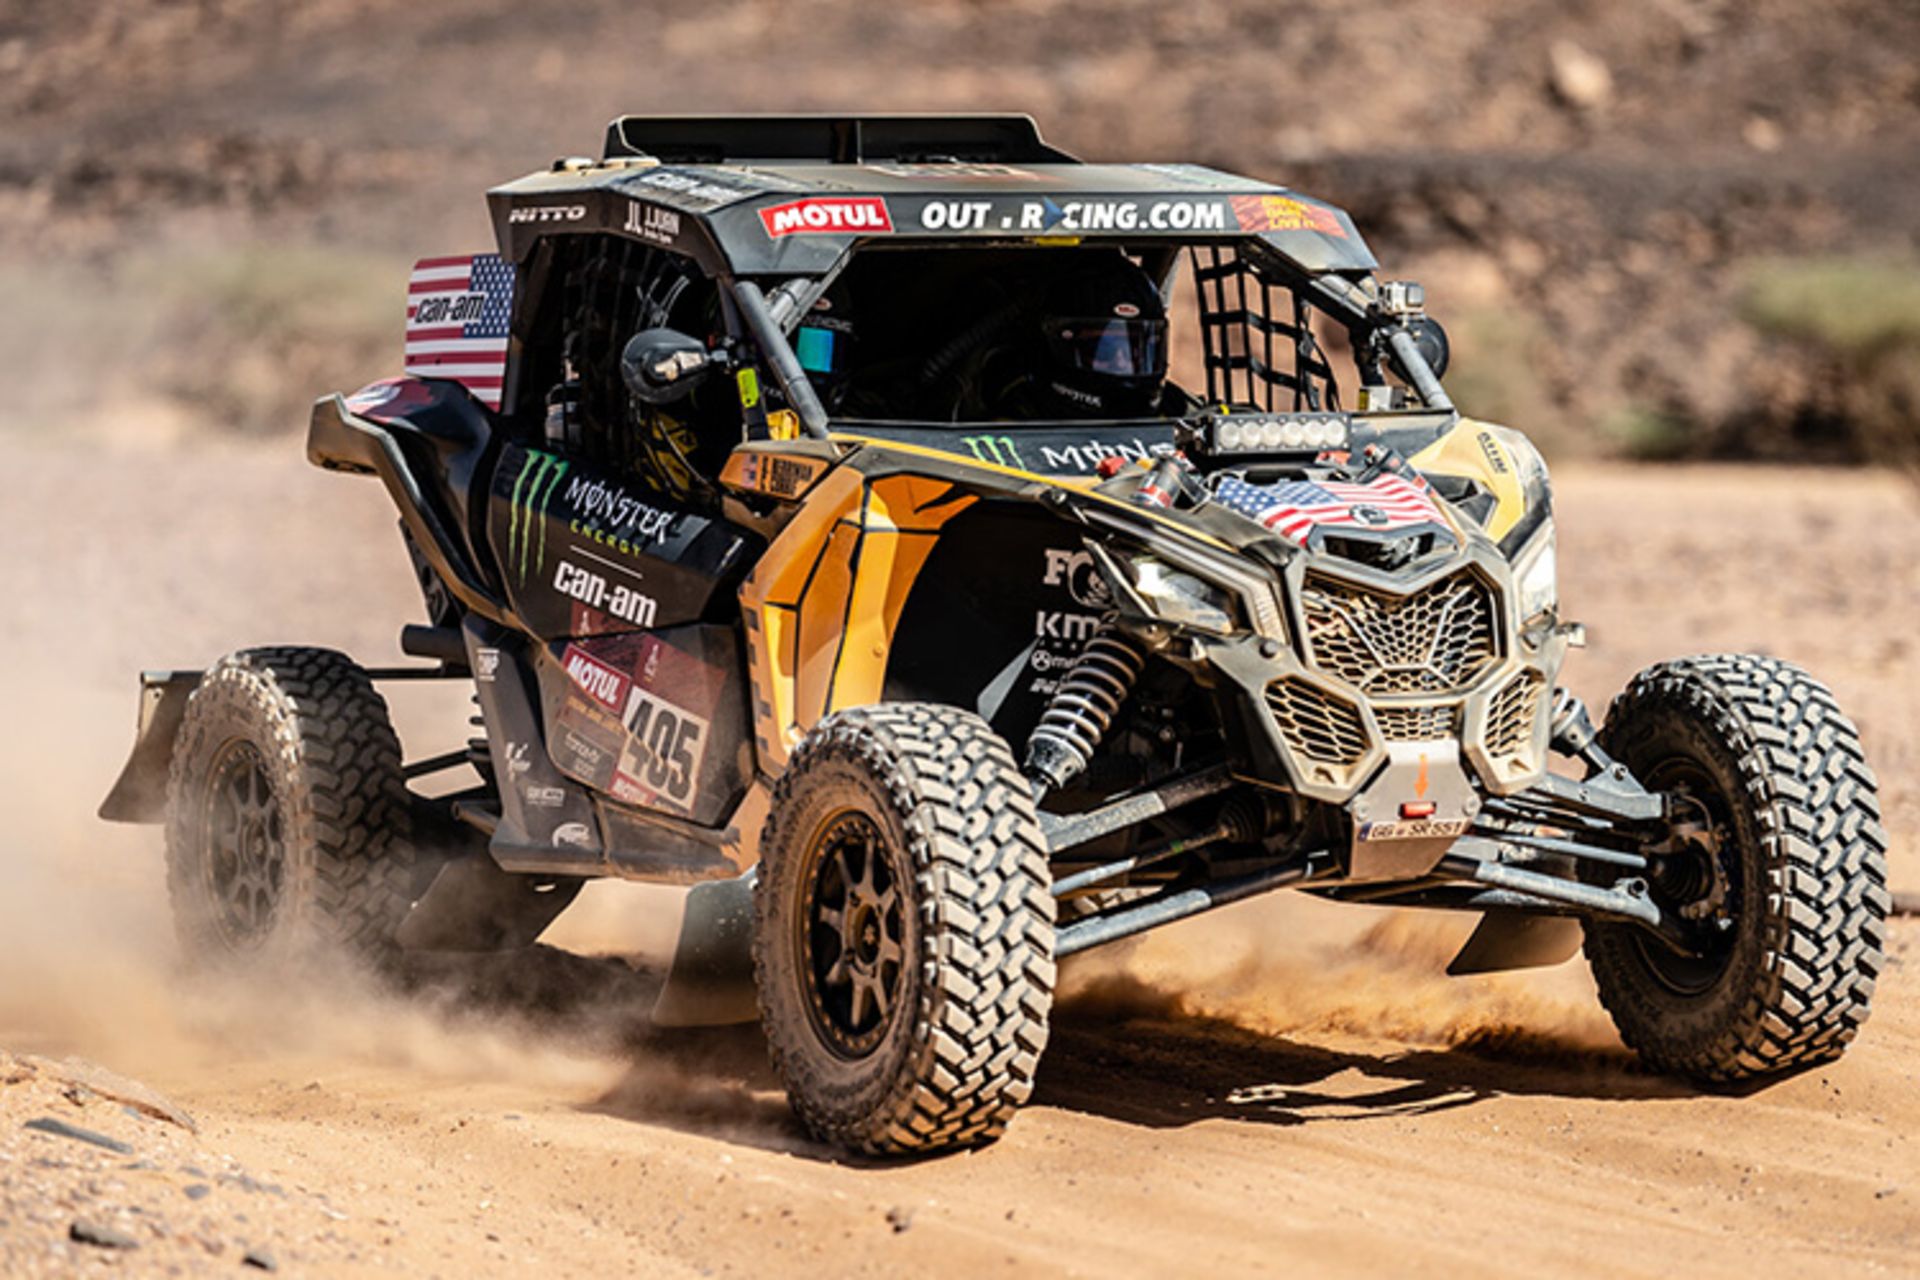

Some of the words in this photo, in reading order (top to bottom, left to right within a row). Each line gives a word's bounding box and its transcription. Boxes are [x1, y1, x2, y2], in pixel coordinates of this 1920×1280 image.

[508, 205, 587, 224] NITTO
[773, 206, 884, 233] MOTUL
[921, 201, 991, 230] OUT
[1021, 201, 1225, 230] RCING.COM
[414, 295, 485, 323] can-am
[570, 519, 642, 558] ENERGY
[554, 560, 657, 628] can-am
[567, 655, 621, 705] MOTUL
[629, 699, 700, 800] 405
